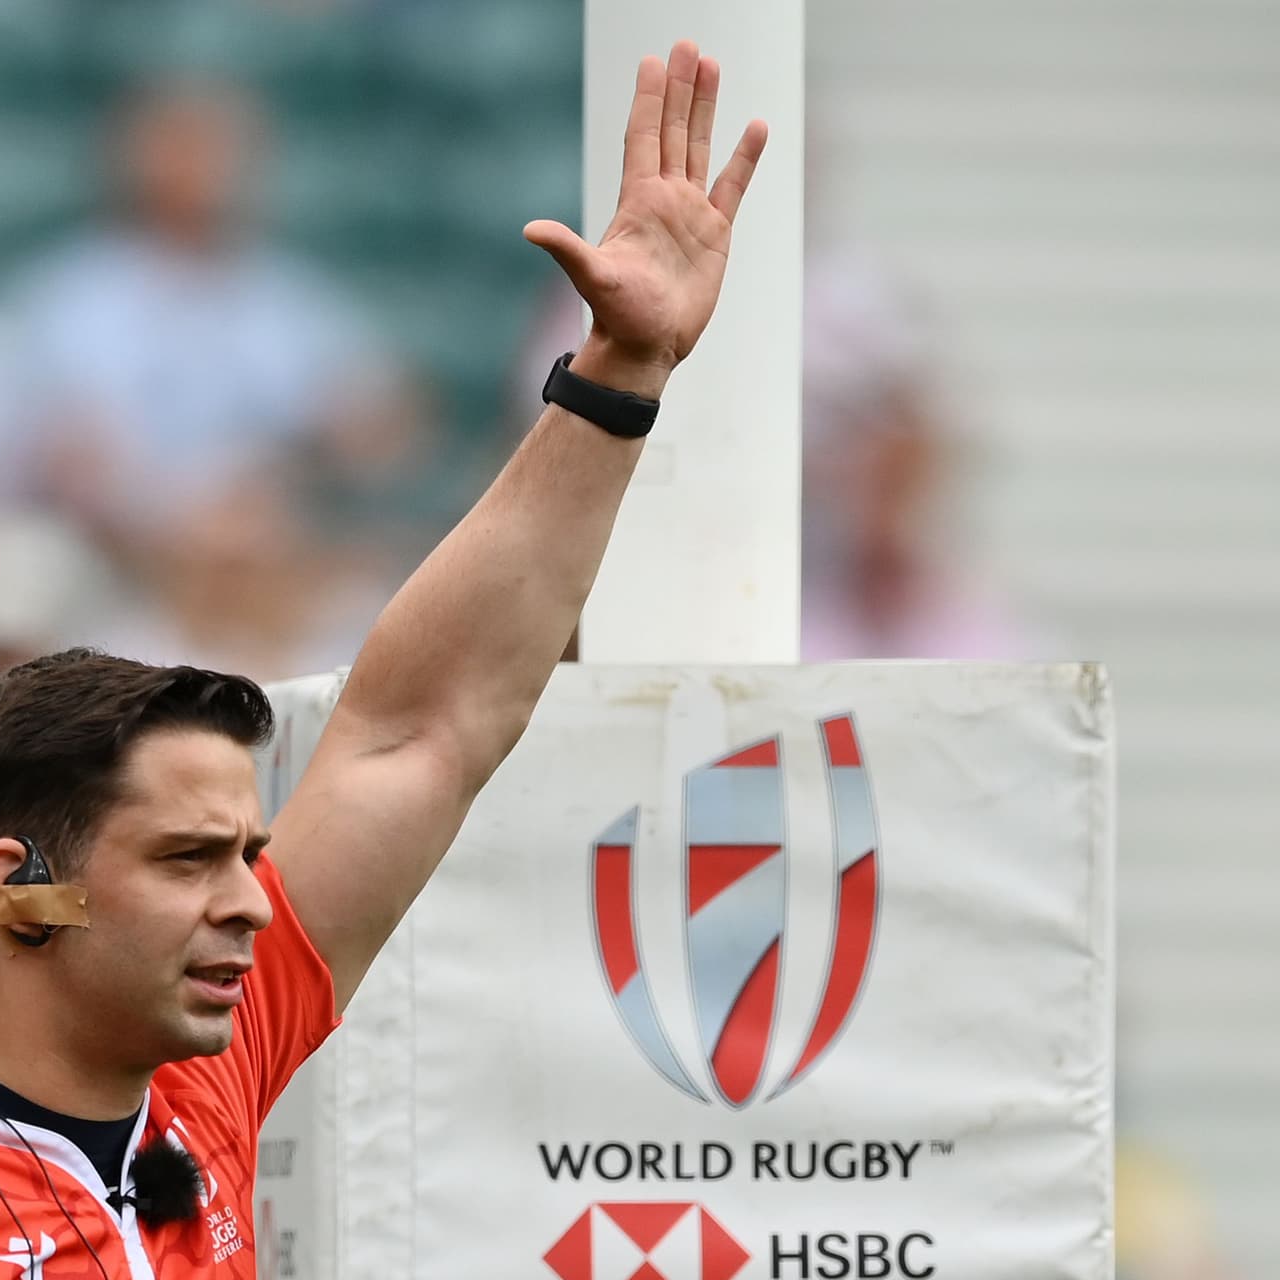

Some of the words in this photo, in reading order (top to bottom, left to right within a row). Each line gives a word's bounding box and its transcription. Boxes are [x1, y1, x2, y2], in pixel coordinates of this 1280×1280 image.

[538, 1141, 734, 1181] WORLD
[206, 1206, 233, 1228] ORLD
[769, 1233, 936, 1280] HSBC
